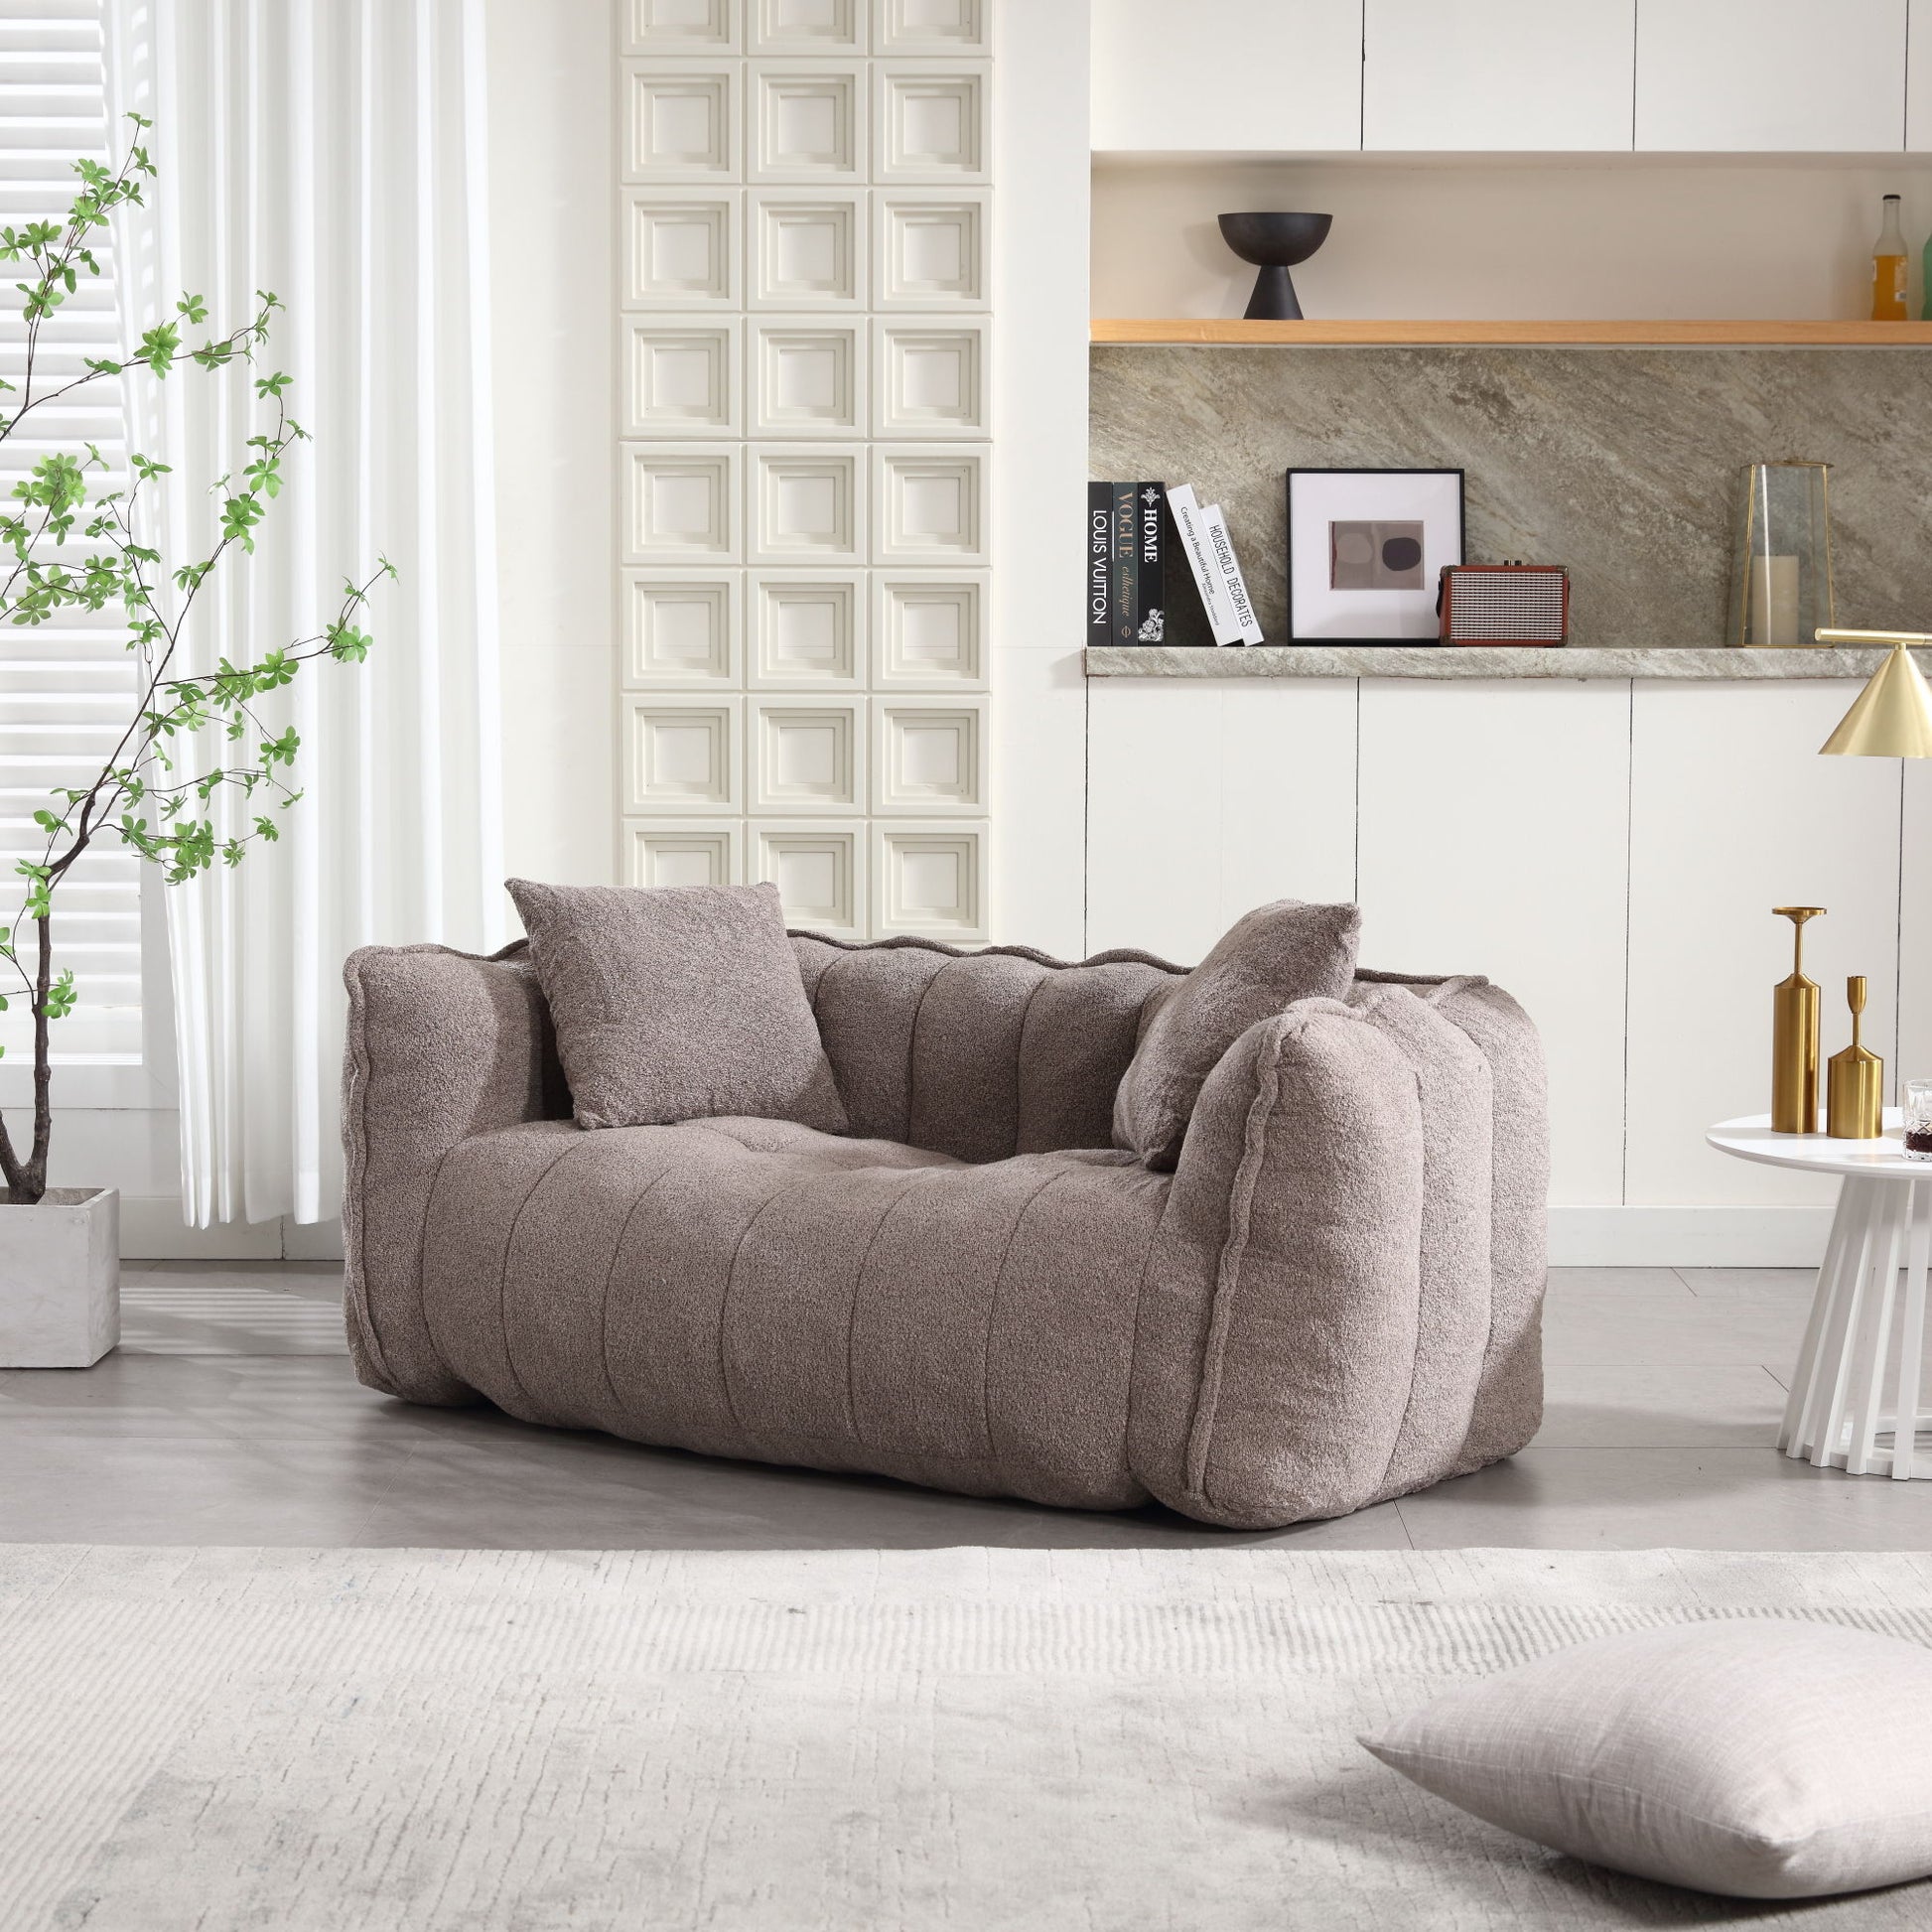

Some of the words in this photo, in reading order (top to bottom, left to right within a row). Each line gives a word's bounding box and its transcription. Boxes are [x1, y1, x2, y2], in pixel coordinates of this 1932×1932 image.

[1093, 510, 1107, 553] LOUIS
[1118, 492, 1134, 558] VOGUE
[1144, 508, 1158, 563] HOME
[1180, 507, 1195, 537] Creating
[1193, 542, 1208, 572] Beautiful
[1204, 573, 1215, 595] Home
[1093, 557, 1107, 624] VUITTON
[1209, 525, 1234, 575] HOUSEHOLD
[1227, 577, 1253, 627] DECORATES
